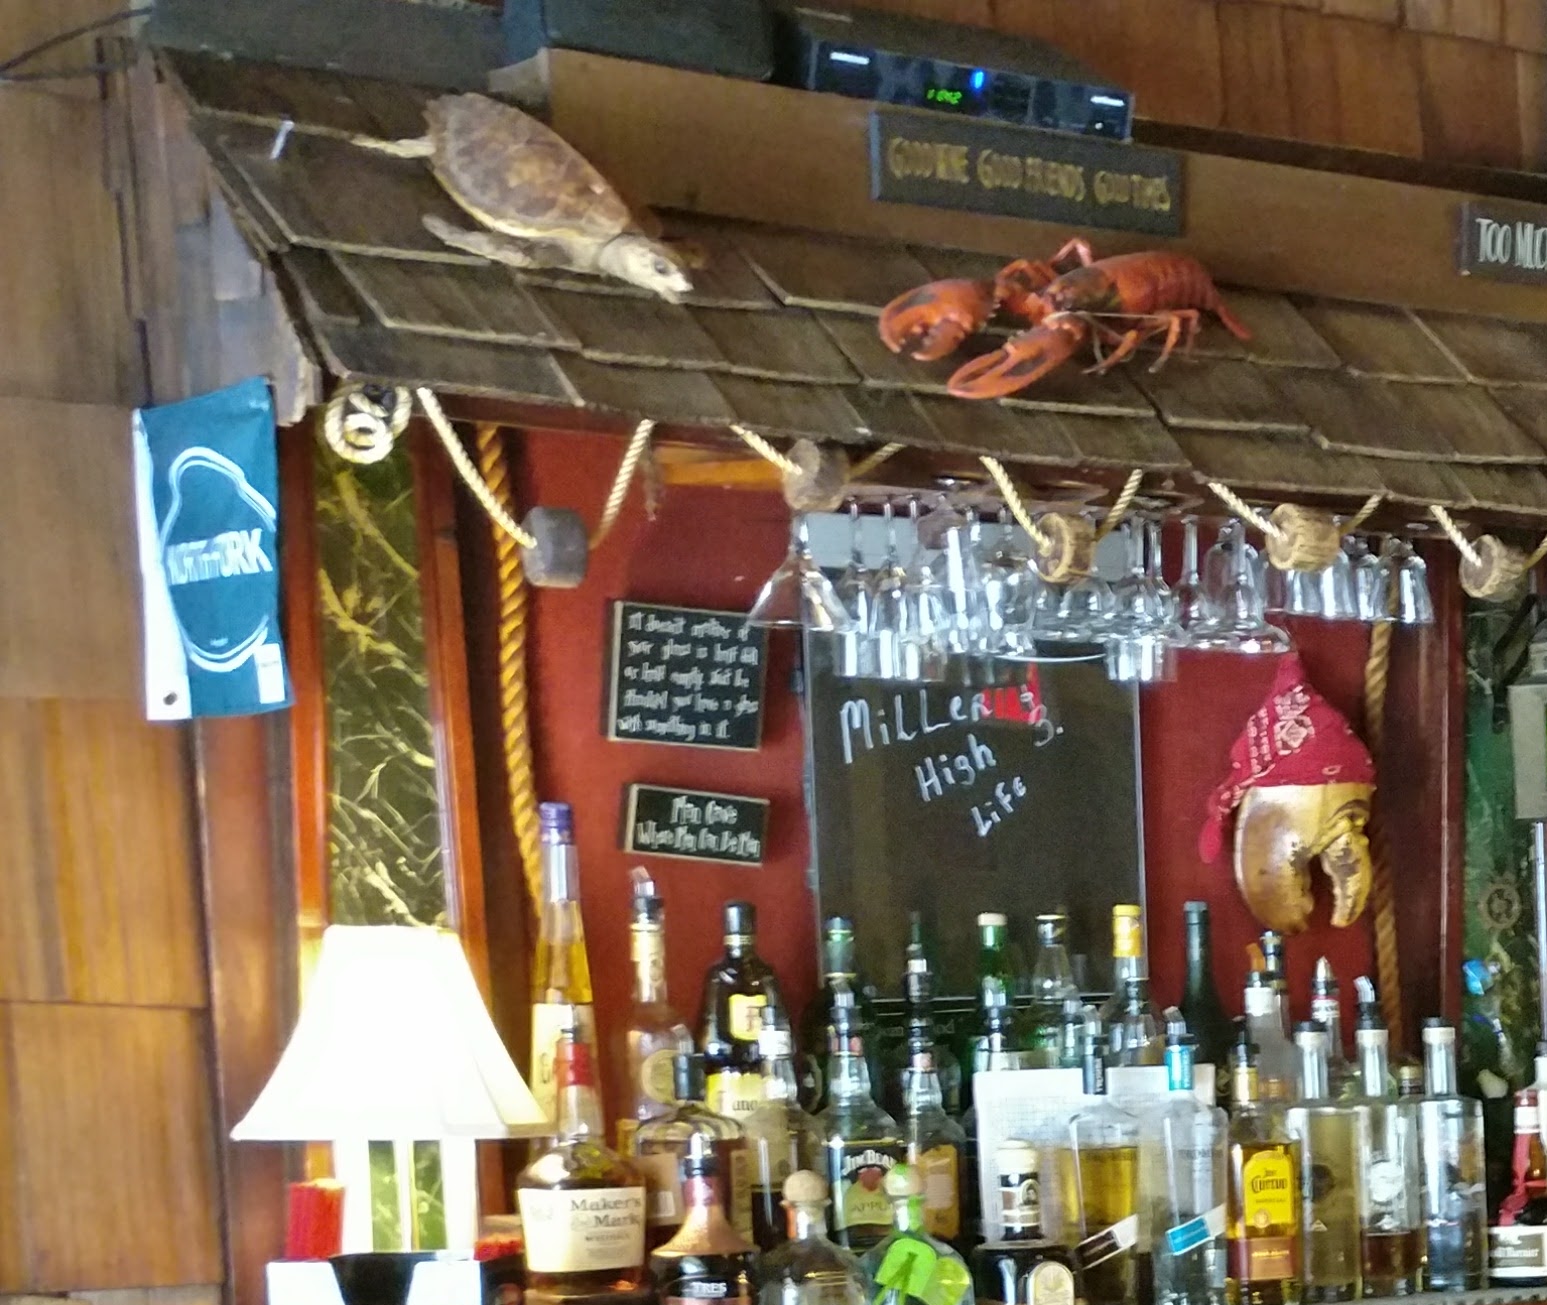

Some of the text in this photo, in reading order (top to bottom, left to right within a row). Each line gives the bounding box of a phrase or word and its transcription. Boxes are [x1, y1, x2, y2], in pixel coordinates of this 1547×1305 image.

[1475, 218, 1513, 264] TOO
[915, 733, 996, 802] High
[570, 1197, 641, 1212] Maker's
[593, 1213, 641, 1228] Mark
